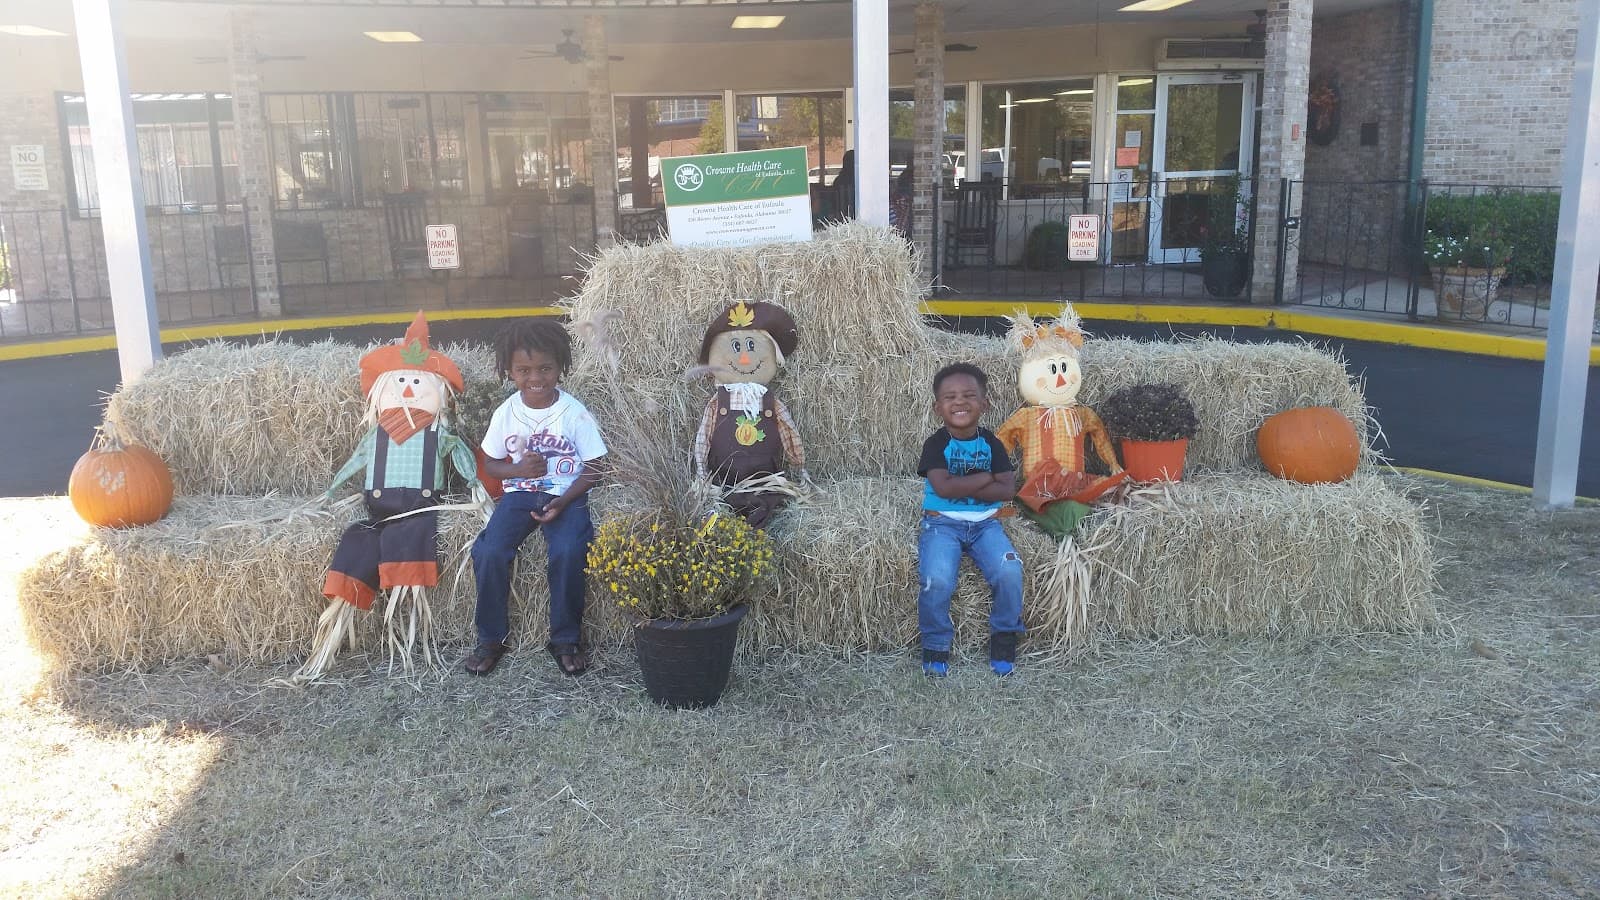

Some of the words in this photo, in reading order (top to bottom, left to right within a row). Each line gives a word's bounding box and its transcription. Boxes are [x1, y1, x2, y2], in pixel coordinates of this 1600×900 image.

[17, 151, 37, 162] NO
[705, 165, 735, 175] Crowne
[736, 160, 762, 173] Health
[763, 160, 782, 171] Care
[692, 207, 716, 215] Crowne
[717, 204, 738, 213] Health
[738, 202, 753, 211] Care
[1079, 219, 1090, 229] NO
[435, 229, 447, 239] NO
[1072, 230, 1096, 240] PARKING
[430, 240, 455, 249] PARKING
[437, 257, 453, 265] ZONE
[505, 426, 576, 457] Cptain
